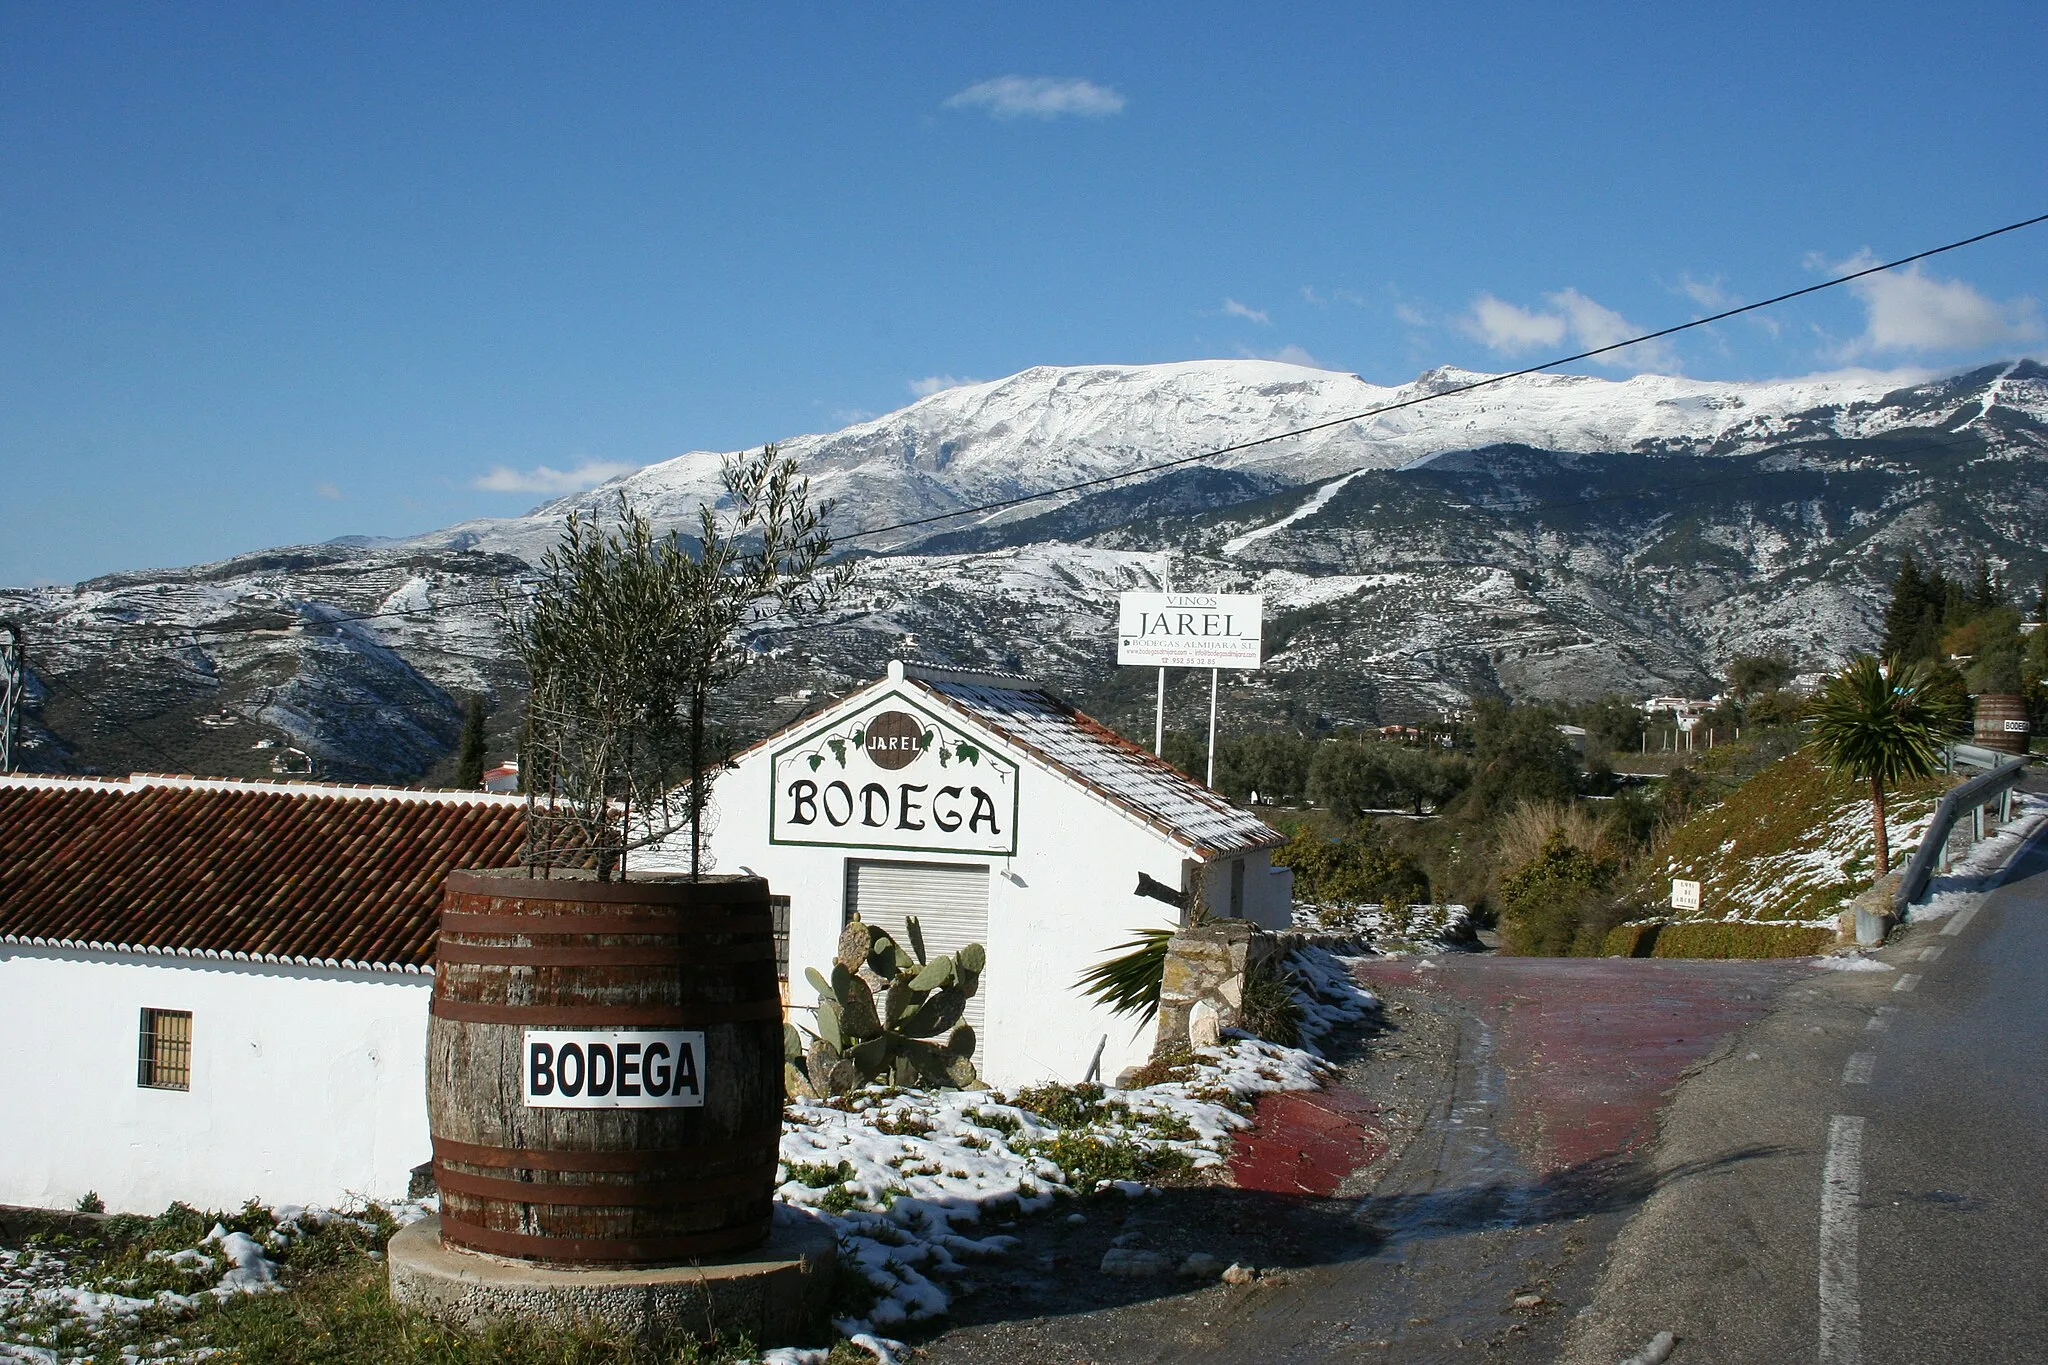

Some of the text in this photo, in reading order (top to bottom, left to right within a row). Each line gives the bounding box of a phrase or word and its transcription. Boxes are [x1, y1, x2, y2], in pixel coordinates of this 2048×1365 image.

[1166, 596, 1217, 606] VINOS
[1138, 612, 1243, 639] JAREL
[1132, 640, 1257, 650] BODEGAS ALMIJARA S.L.
[868, 736, 919, 751] JAREL
[787, 779, 1001, 835] BODEGA
[530, 1042, 700, 1098] BODEGA
